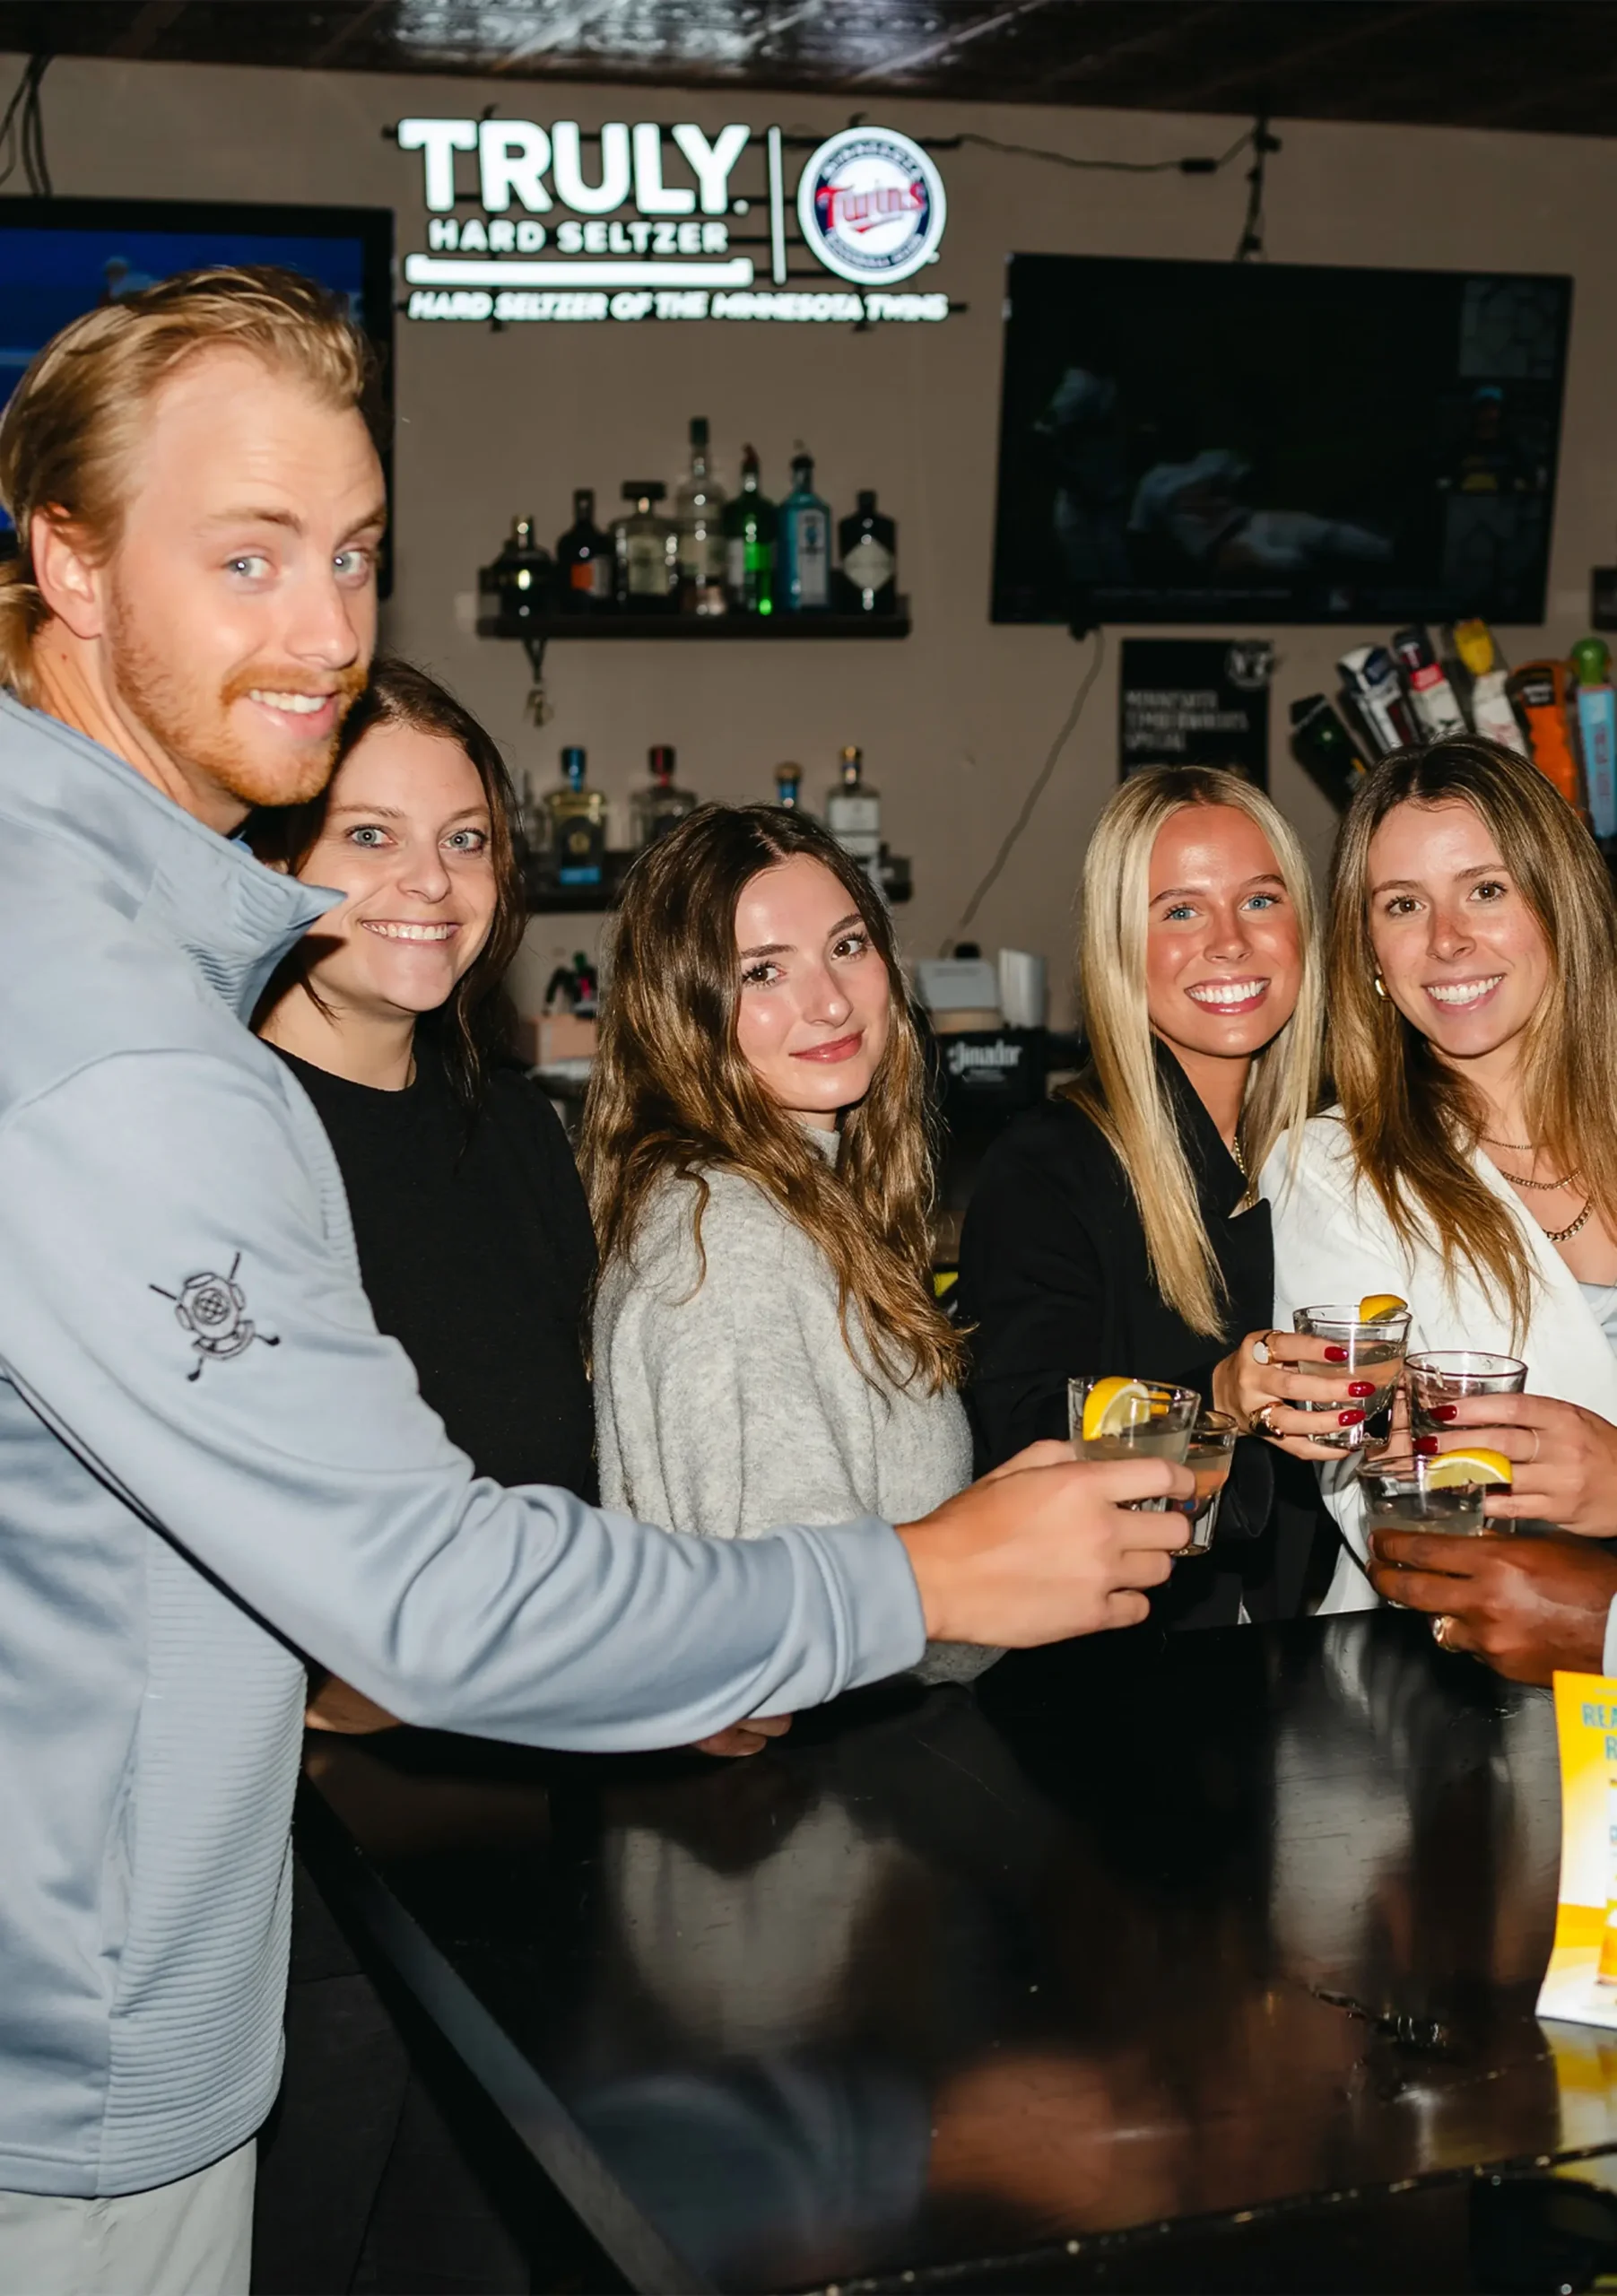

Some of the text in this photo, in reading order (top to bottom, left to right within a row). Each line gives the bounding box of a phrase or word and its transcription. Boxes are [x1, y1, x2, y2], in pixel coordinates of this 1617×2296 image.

[815, 179, 927, 233] Twins
[428, 218, 728, 254] HARD SELTZER
[408, 291, 948, 322] HARD SELTZER OF THE MINNESOTA TWINS
